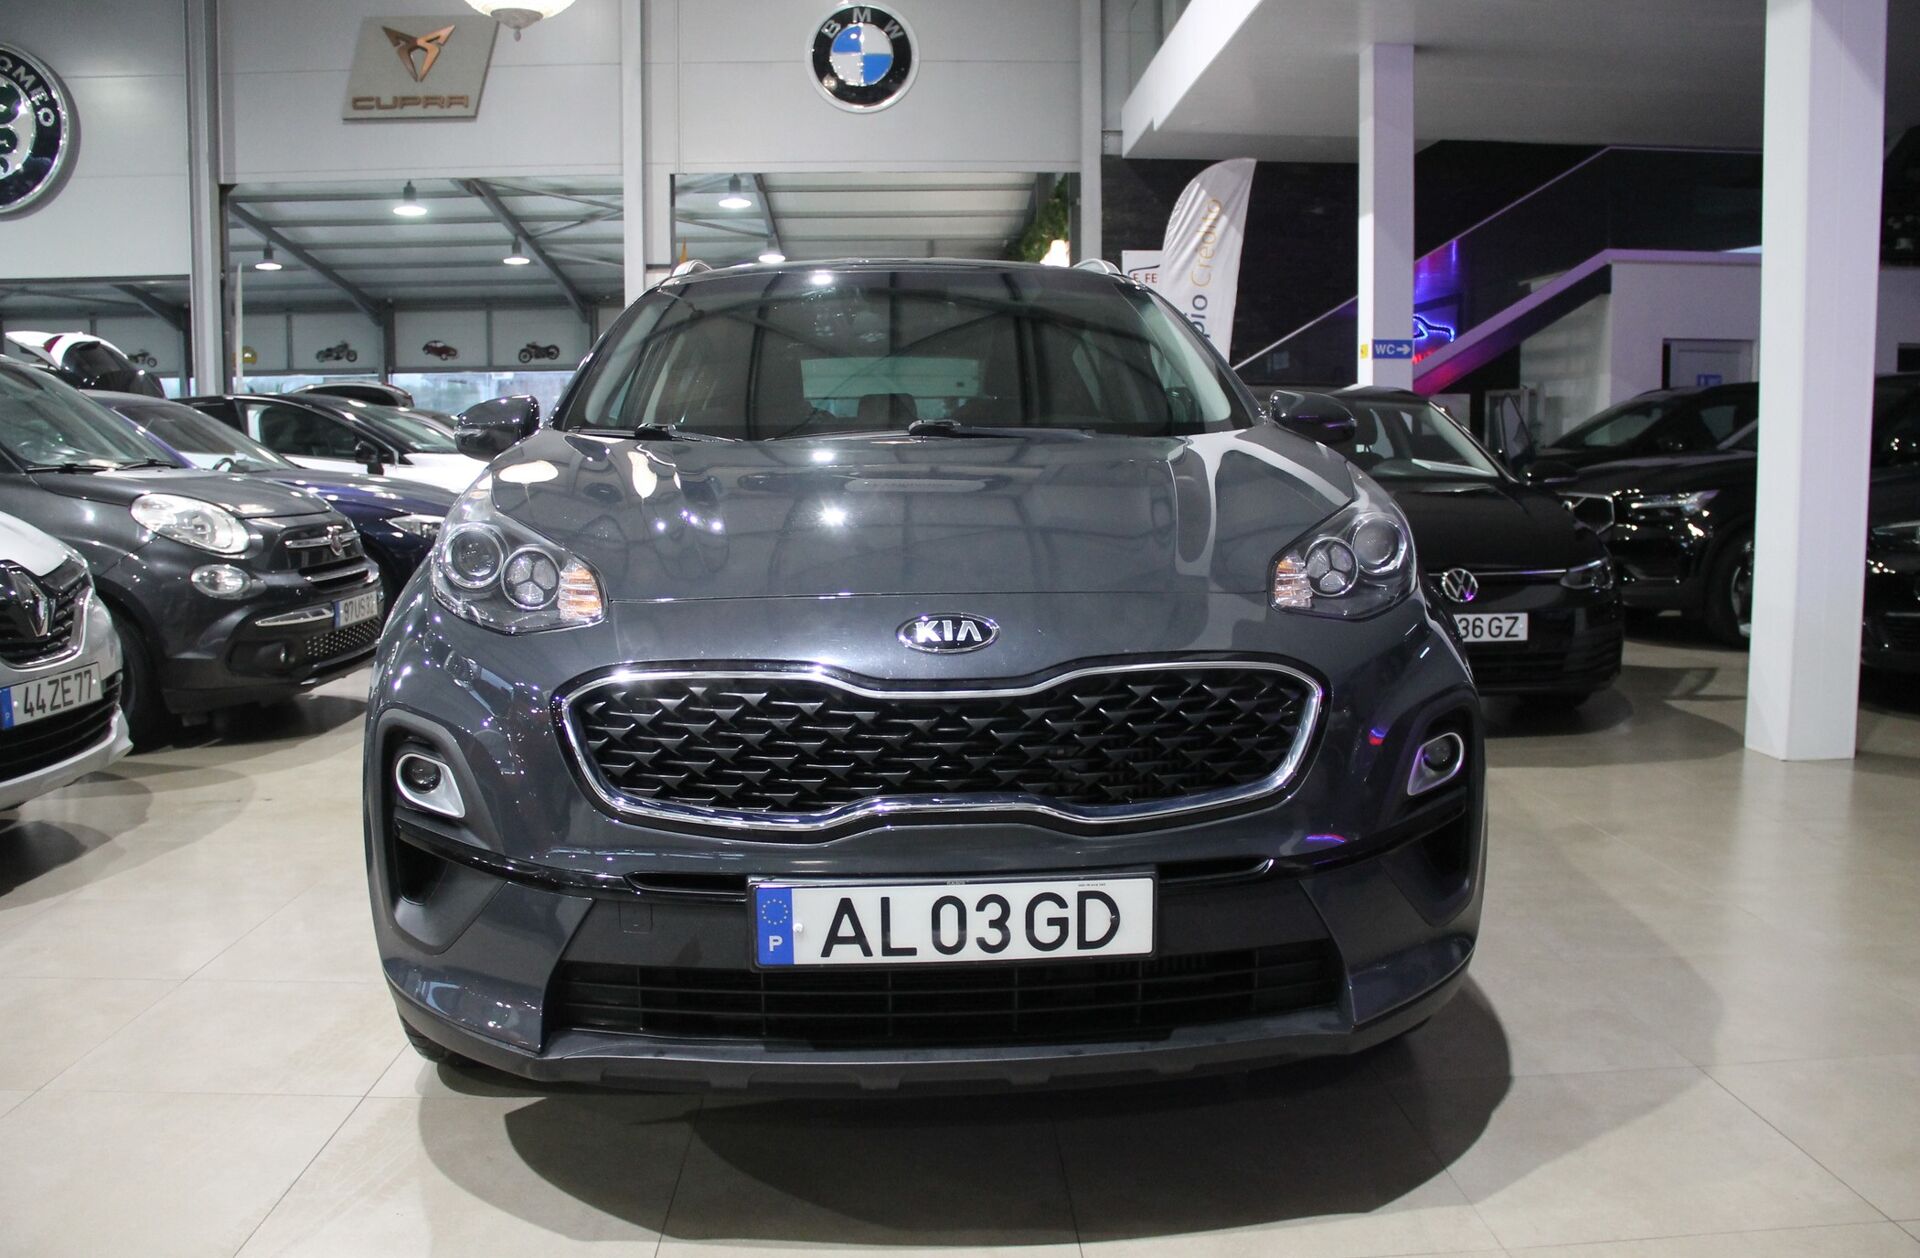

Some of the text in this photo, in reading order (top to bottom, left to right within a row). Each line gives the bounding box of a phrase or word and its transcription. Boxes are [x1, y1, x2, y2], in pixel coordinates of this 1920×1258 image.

[821, 7, 904, 39] BMW
[352, 96, 469, 110] CUPRA
[1375, 344, 1395, 354] WC
[914, 620, 982, 642] KIA
[24, 669, 92, 717] 44ZE77
[769, 935, 783, 952] P
